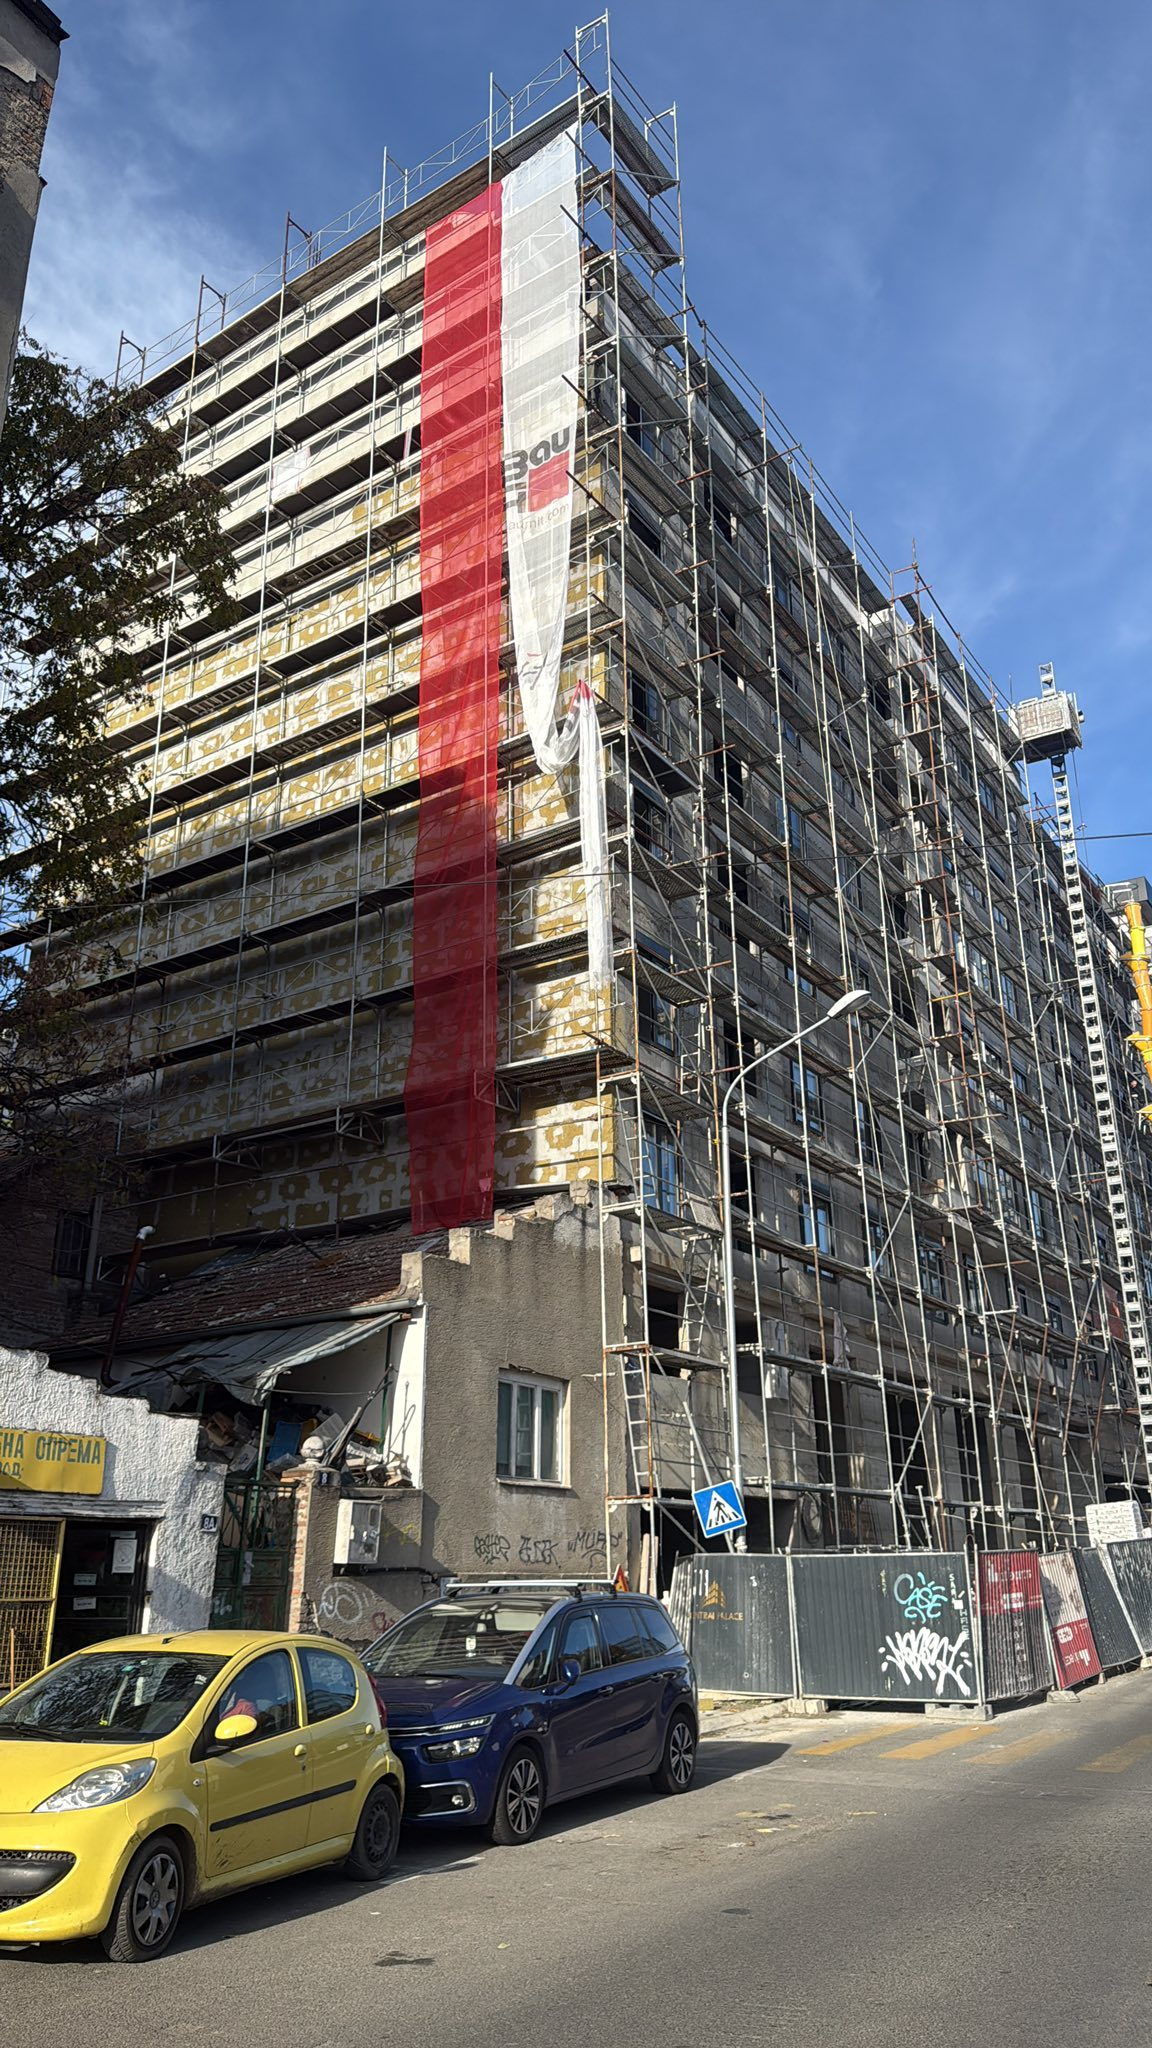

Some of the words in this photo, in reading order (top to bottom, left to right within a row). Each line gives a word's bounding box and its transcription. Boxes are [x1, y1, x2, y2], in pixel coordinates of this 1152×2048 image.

[0, 1431, 25, 1459] НА
[35, 1435, 101, 1465] ОПРЕМА
[321, 1472, 329, 1485] 8
[203, 1515, 216, 1529] 8A
